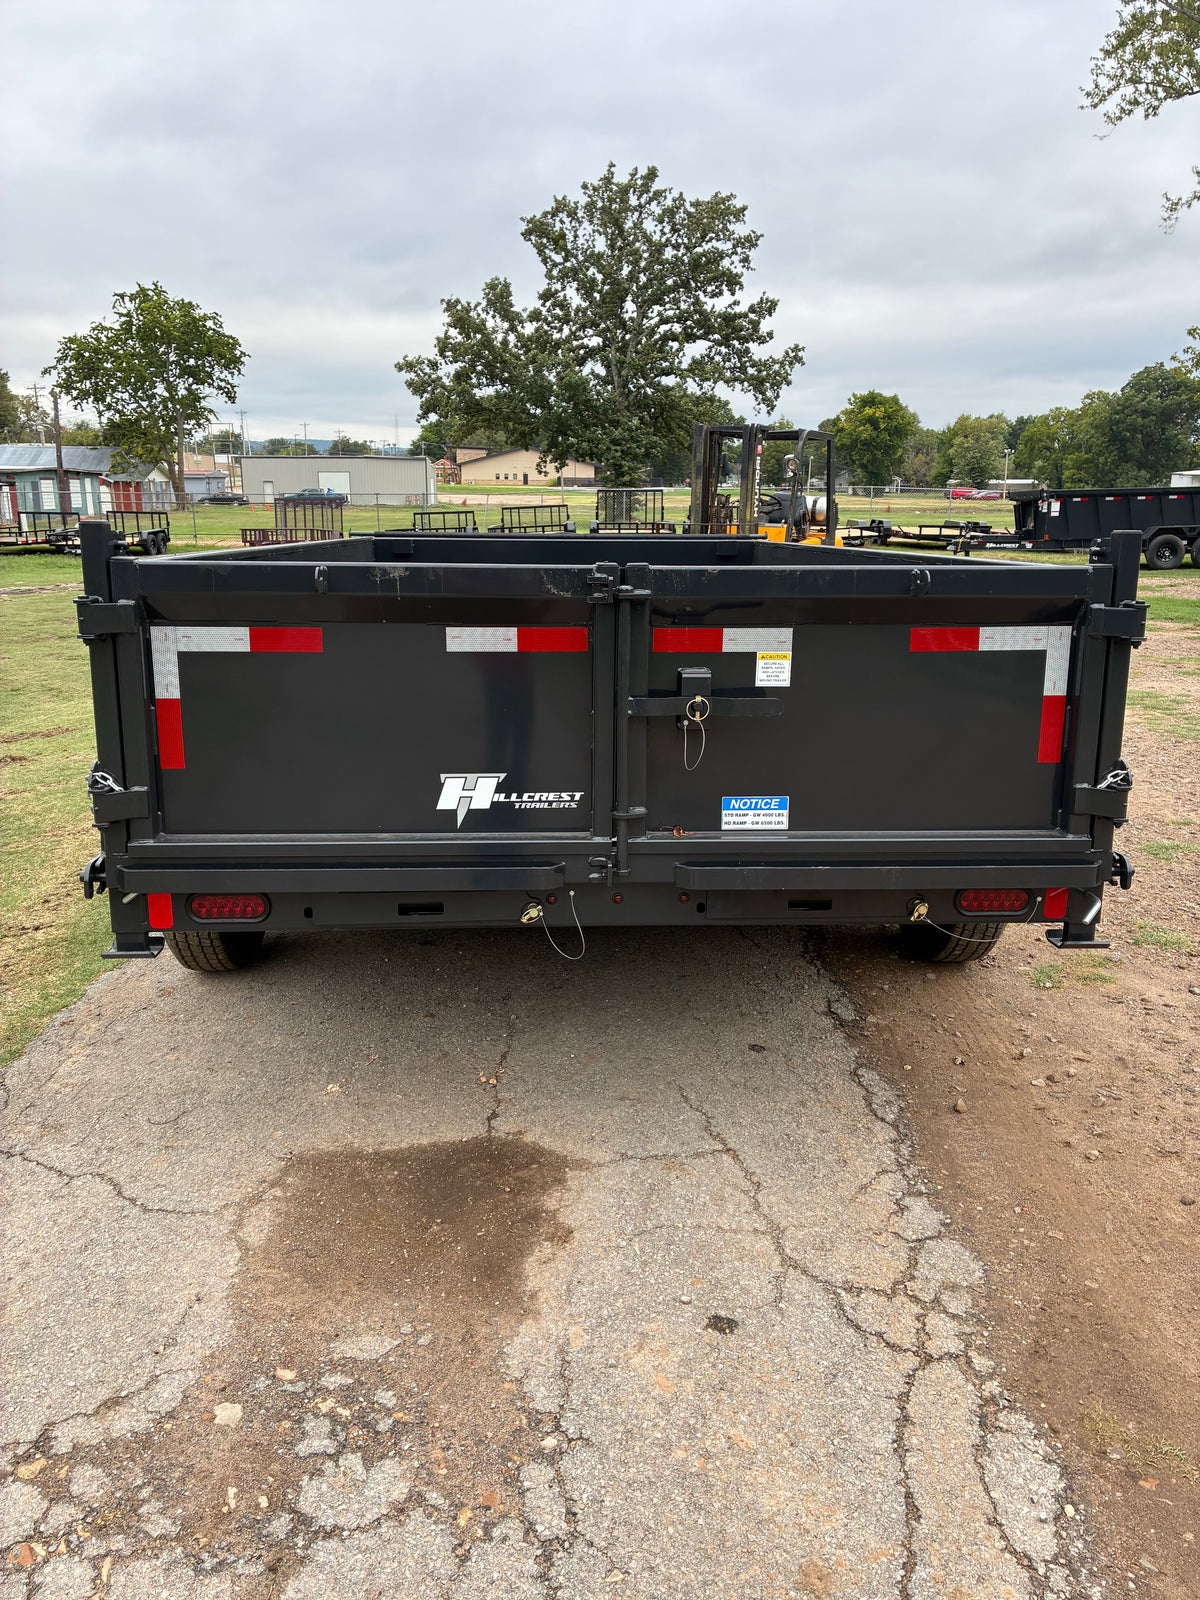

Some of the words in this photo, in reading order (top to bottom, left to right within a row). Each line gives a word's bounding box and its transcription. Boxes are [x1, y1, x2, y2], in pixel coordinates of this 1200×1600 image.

[436, 773, 585, 811] HILLCREST
[513, 801, 579, 809] TRAILERS
[729, 798, 780, 810] NOTICE
